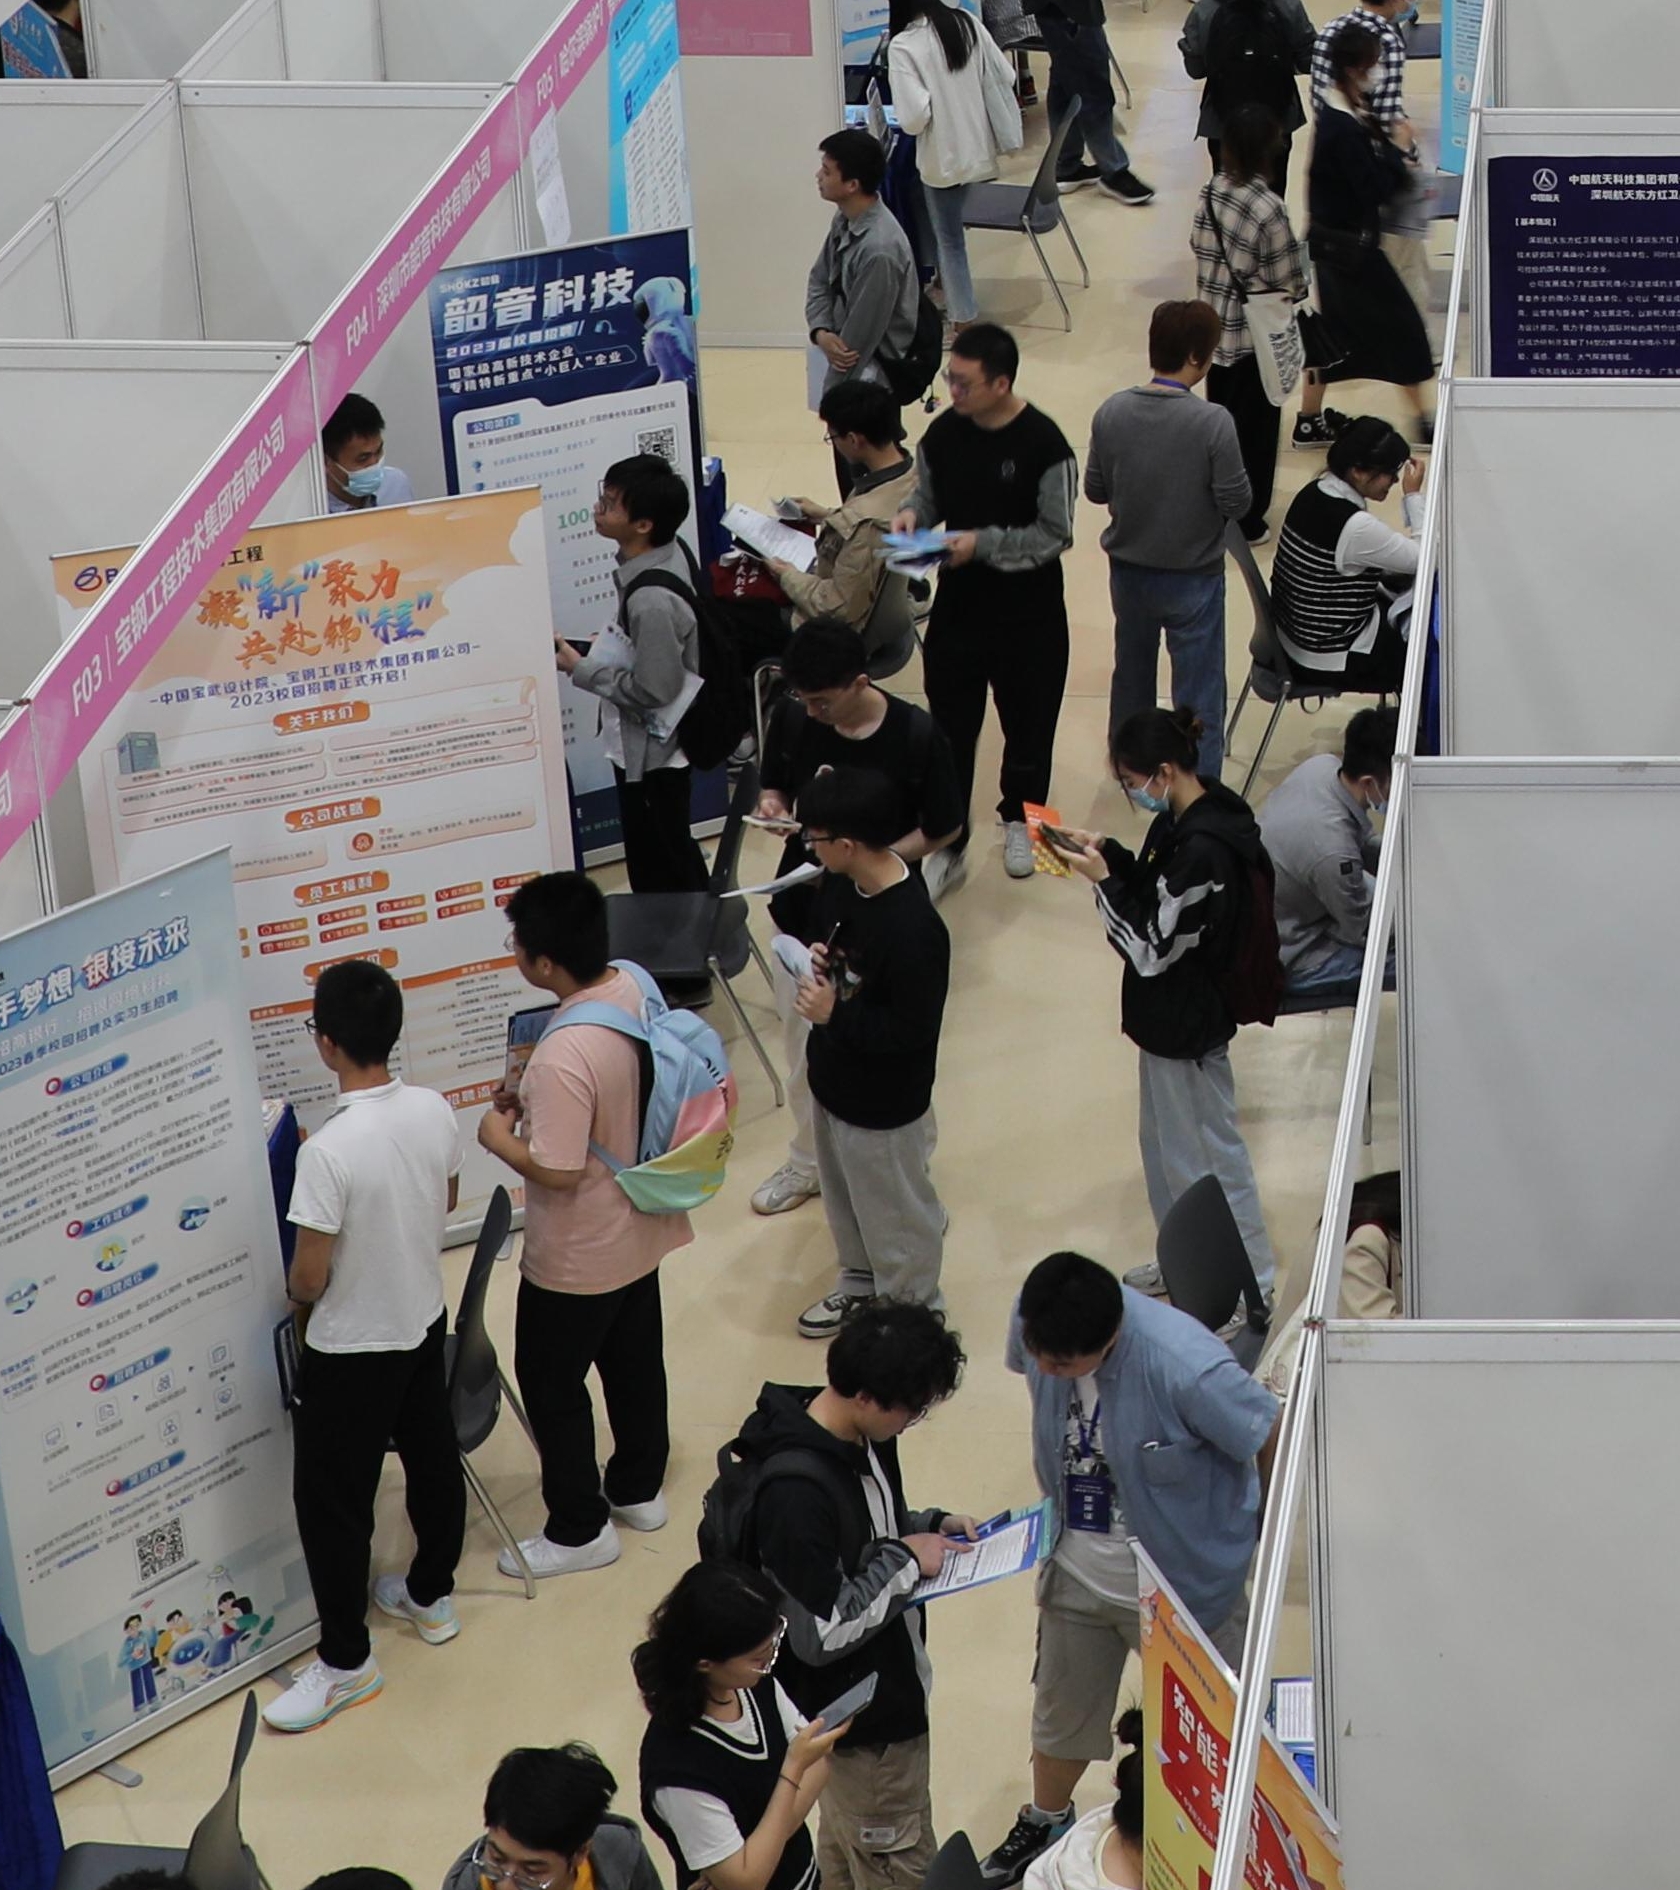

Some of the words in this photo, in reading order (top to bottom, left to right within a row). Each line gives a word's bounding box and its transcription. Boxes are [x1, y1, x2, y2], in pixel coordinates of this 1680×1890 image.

[441, 267, 636, 338] 韶音科技
[345, 305, 369, 357] F04
[445, 321, 579, 361] 2023届校园招聘
[447, 344, 576, 381] 国家级高新技术企业
[68, 648, 110, 721] F03
[112, 409, 290, 665] 宝钢工程技术集团有限公司
[288, 704, 356, 731] 关于我们
[300, 801, 366, 828] 公司战略
[308, 876, 376, 904] 员工福利
[82, 915, 191, 990] 银接未来
